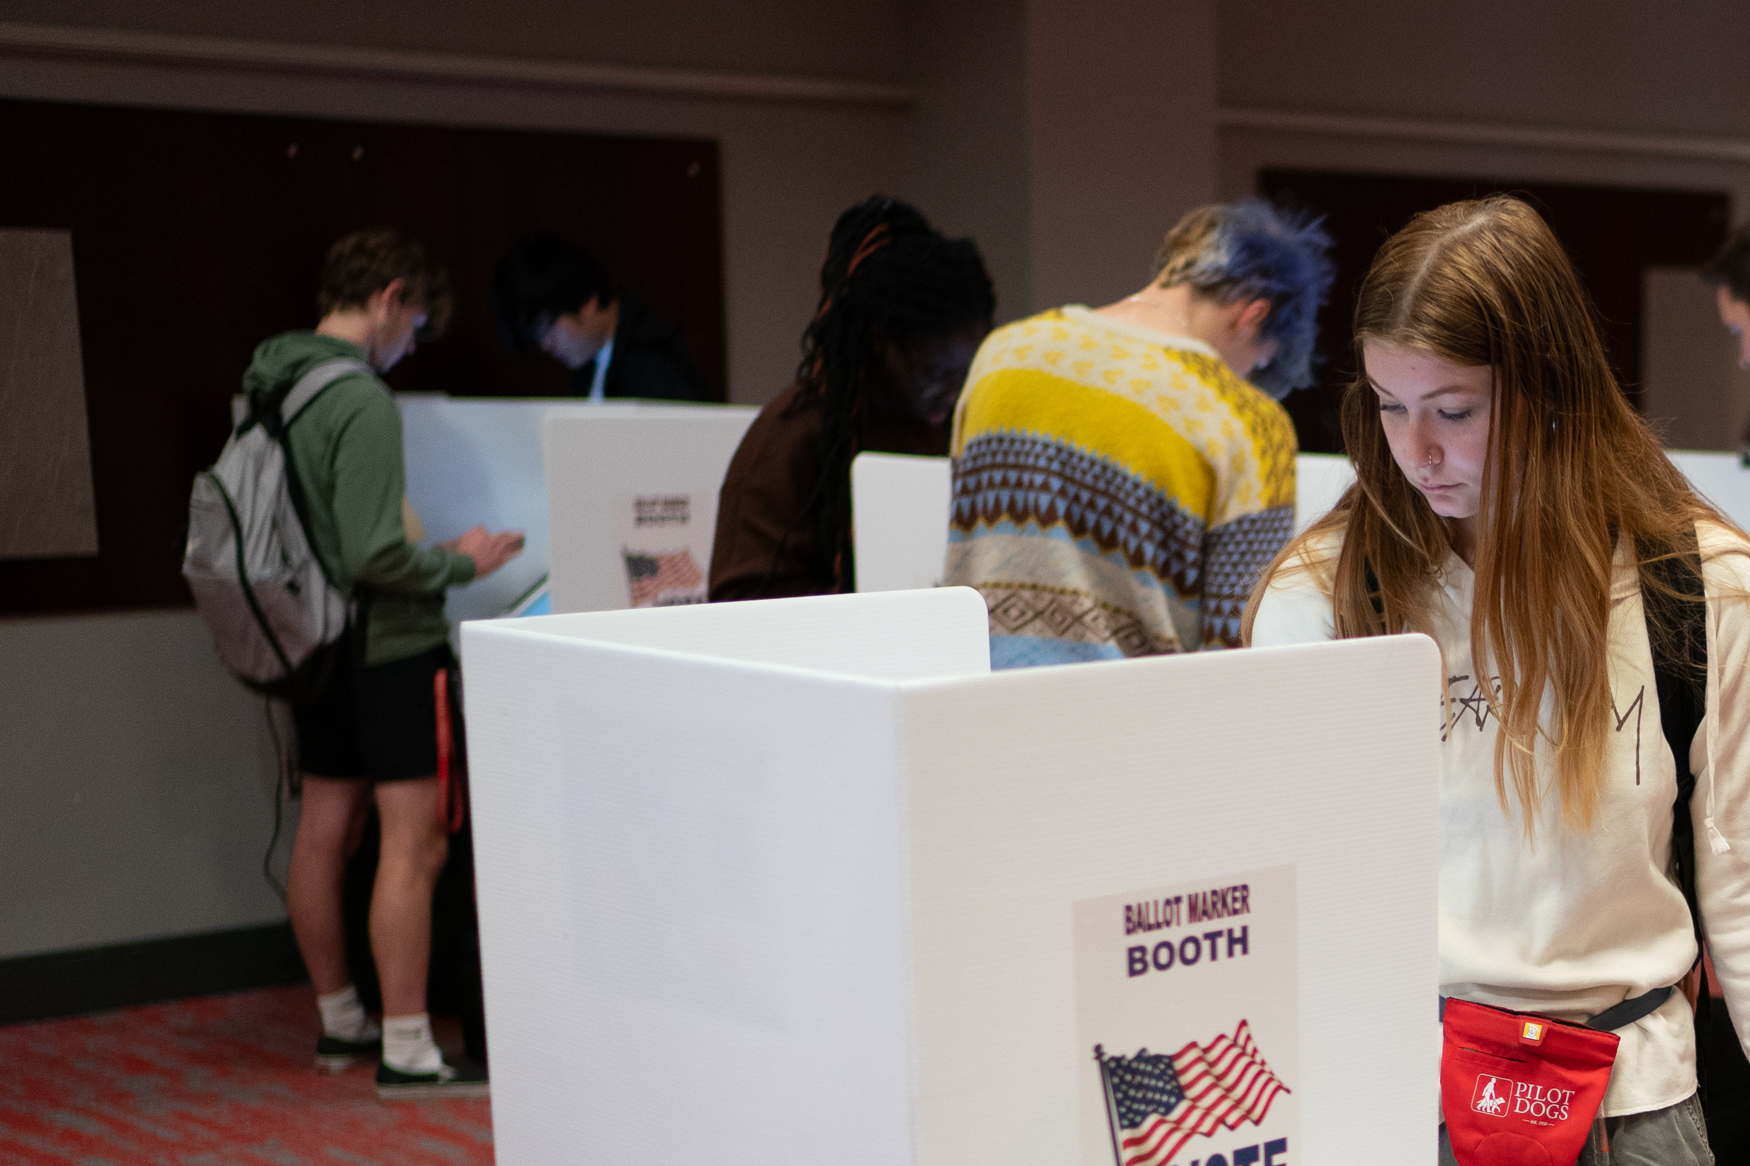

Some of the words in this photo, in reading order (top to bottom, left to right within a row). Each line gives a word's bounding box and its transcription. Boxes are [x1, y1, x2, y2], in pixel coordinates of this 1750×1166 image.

[1124, 896, 1183, 936] BALLOT
[1187, 884, 1250, 925] MARKER
[1126, 925, 1250, 978] BOOTH
[1513, 1098, 1569, 1121] DOGS
[1514, 1082, 1575, 1105] PILOT
